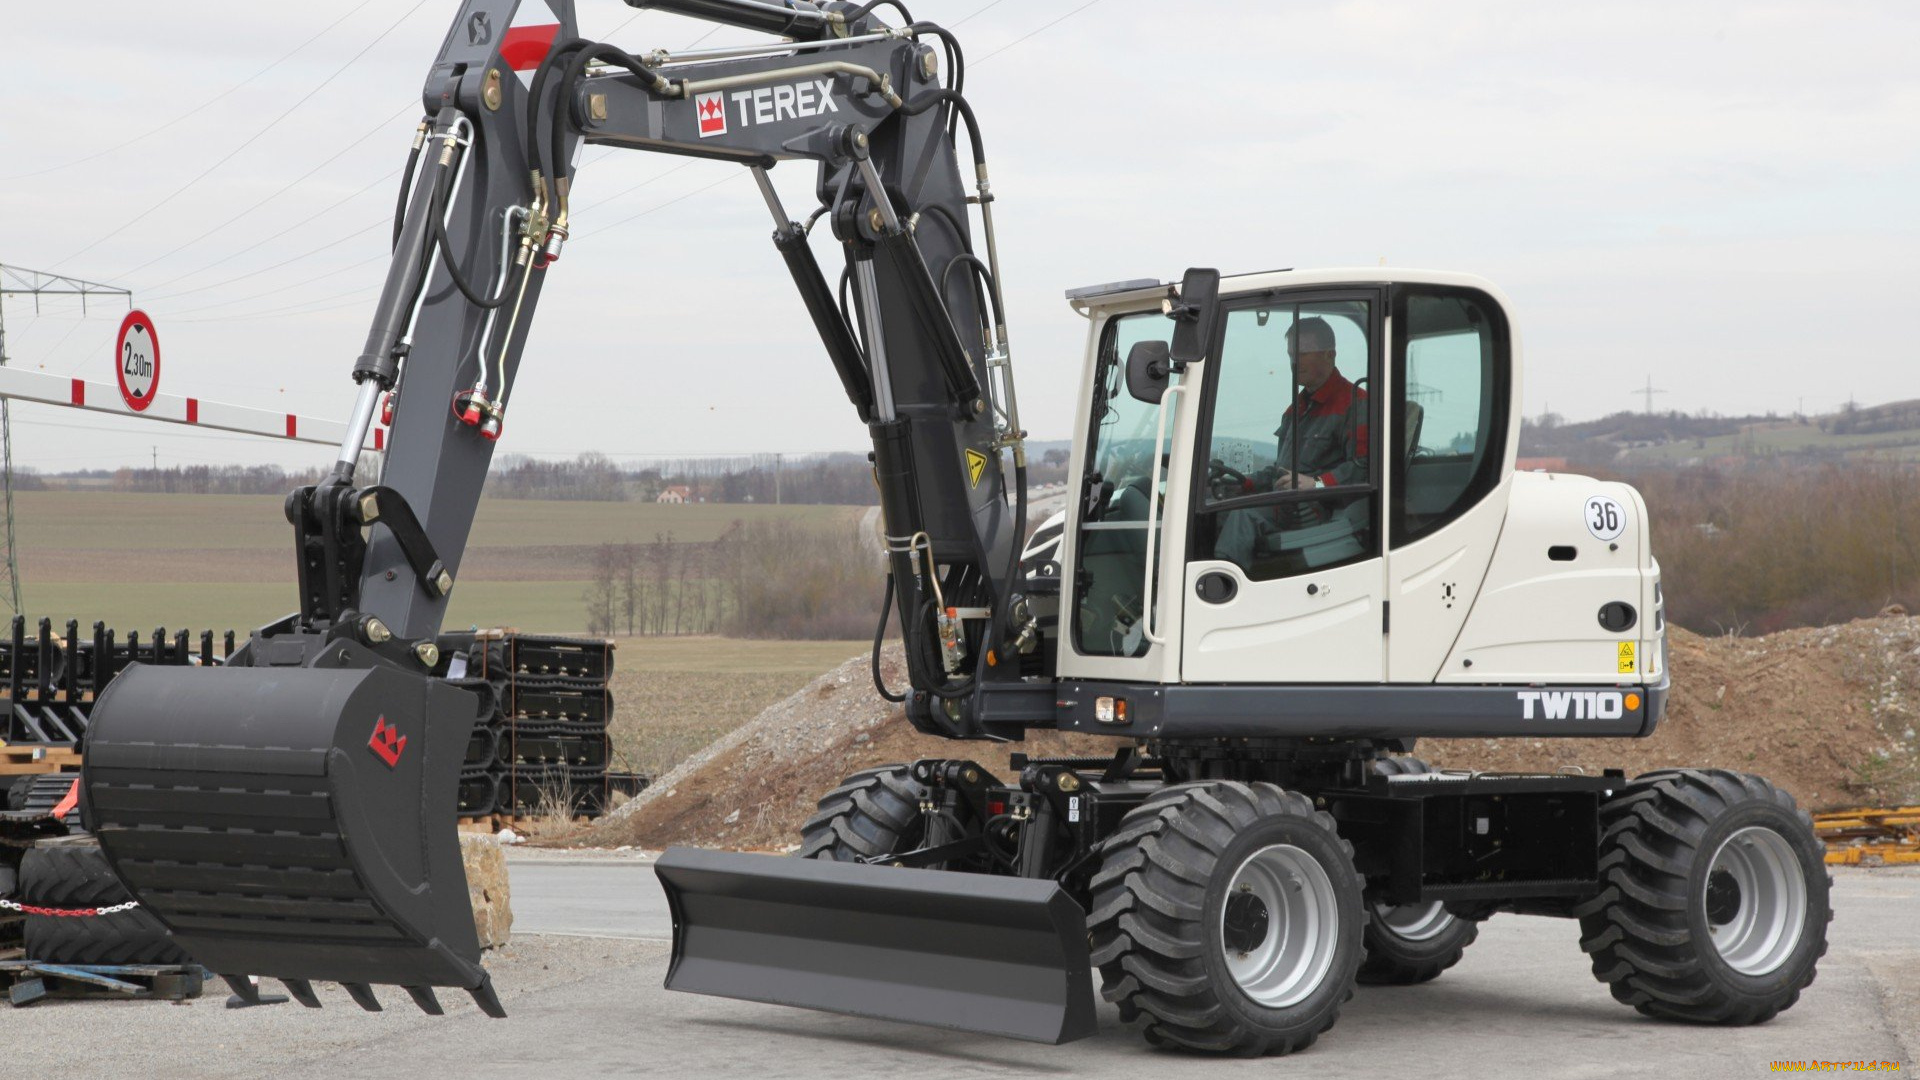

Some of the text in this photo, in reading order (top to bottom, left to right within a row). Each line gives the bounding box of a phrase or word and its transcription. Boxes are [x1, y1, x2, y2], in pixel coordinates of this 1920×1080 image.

[731, 78, 839, 127] TEREX
[1590, 501, 1618, 531] 36
[1517, 691, 1623, 719] TW110
